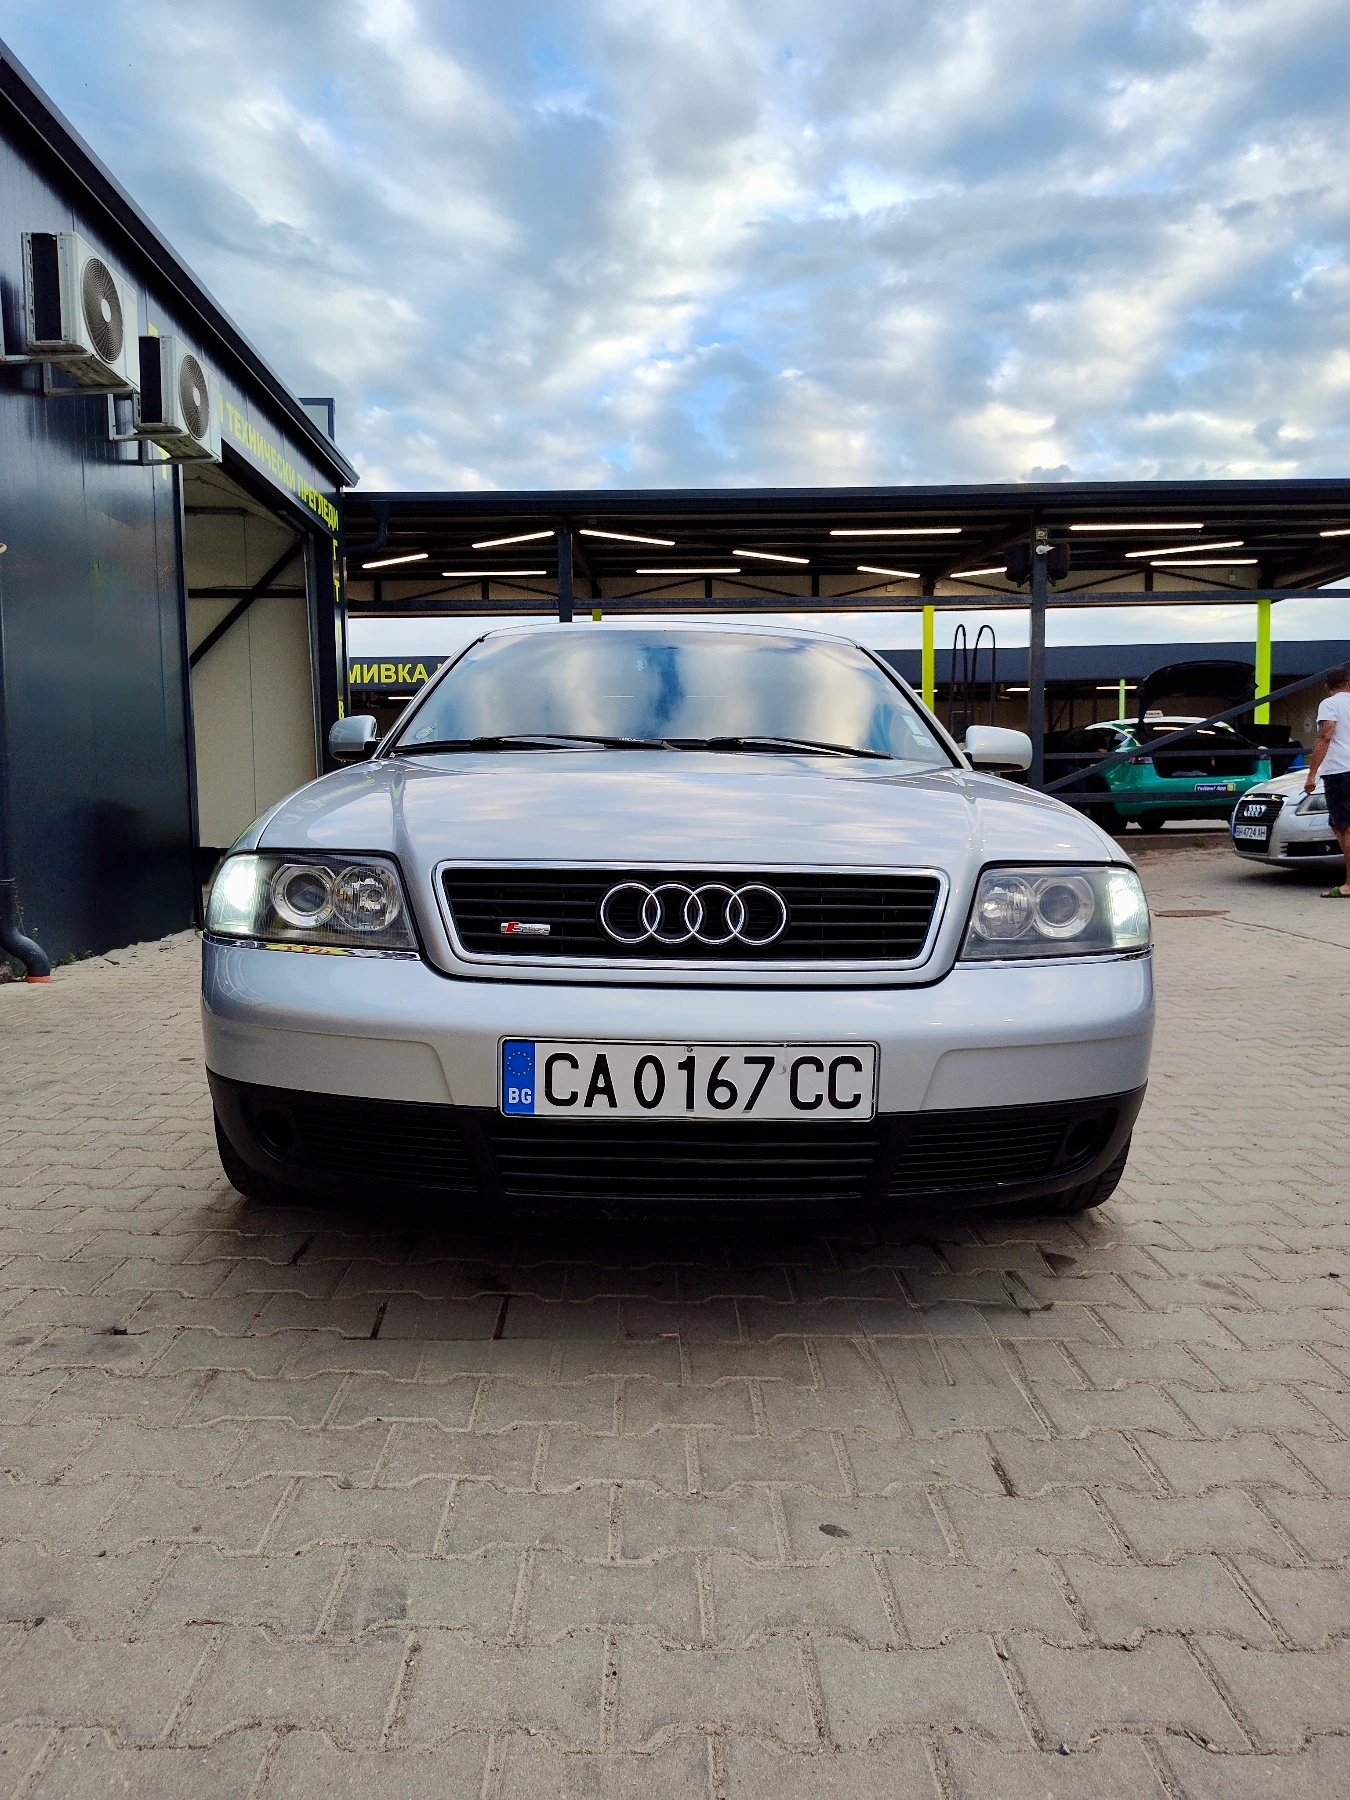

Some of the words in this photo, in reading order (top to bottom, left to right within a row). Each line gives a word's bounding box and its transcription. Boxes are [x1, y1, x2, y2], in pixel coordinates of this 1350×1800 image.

[225, 400, 295, 493] ТЕХНИЧЕСКИ
[297, 473, 339, 532] ПРЕГЛЕДИ
[508, 1087, 532, 1104] BG
[543, 1051, 618, 1109] CA
[633, 1053, 776, 1114] 0167
[789, 1055, 863, 1111] CC
